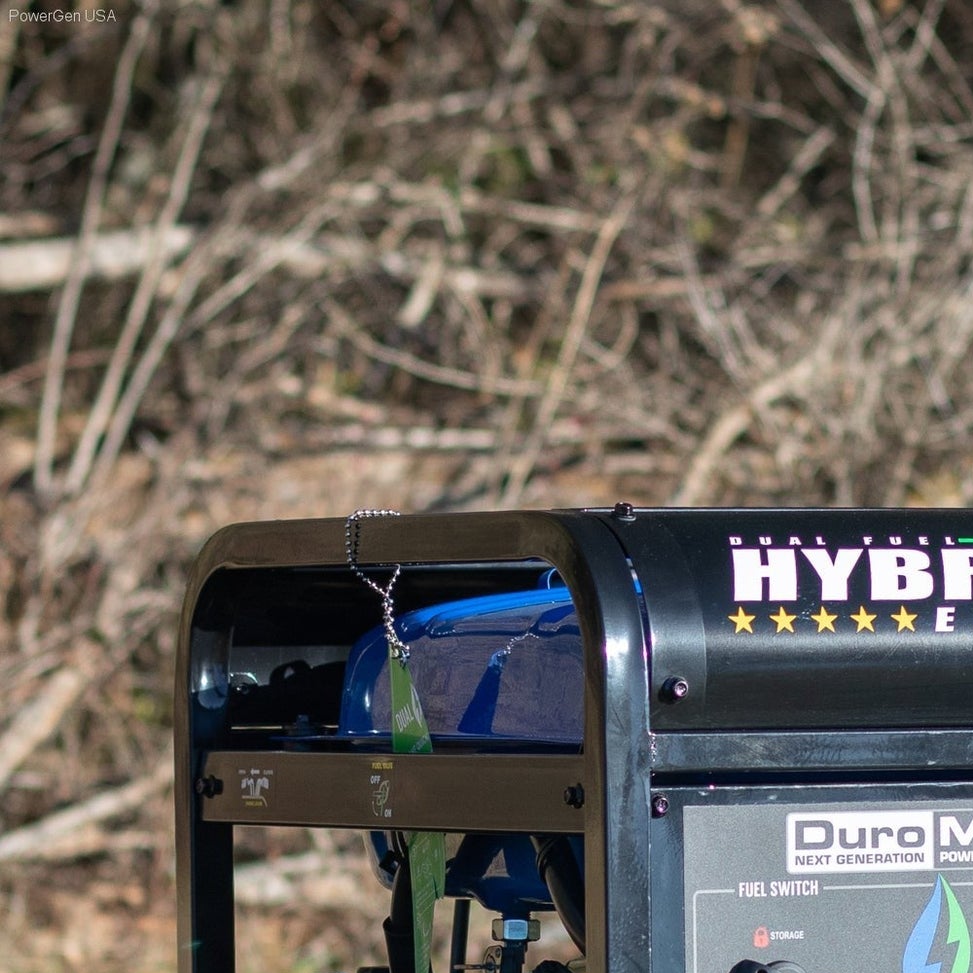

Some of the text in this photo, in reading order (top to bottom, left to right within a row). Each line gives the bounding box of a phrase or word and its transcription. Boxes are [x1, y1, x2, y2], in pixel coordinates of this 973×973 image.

[729, 536, 955, 545] DUAL FUEL
[395, 703, 414, 732] DUAL
[370, 775, 381, 784] OFF
[384, 808, 392, 817] ON
[794, 820, 926, 852] Duro
[794, 852, 925, 866] NEXT GENERATION
[738, 881, 819, 898] FUEL SWITCH
[770, 930, 804, 941] STORAGE
